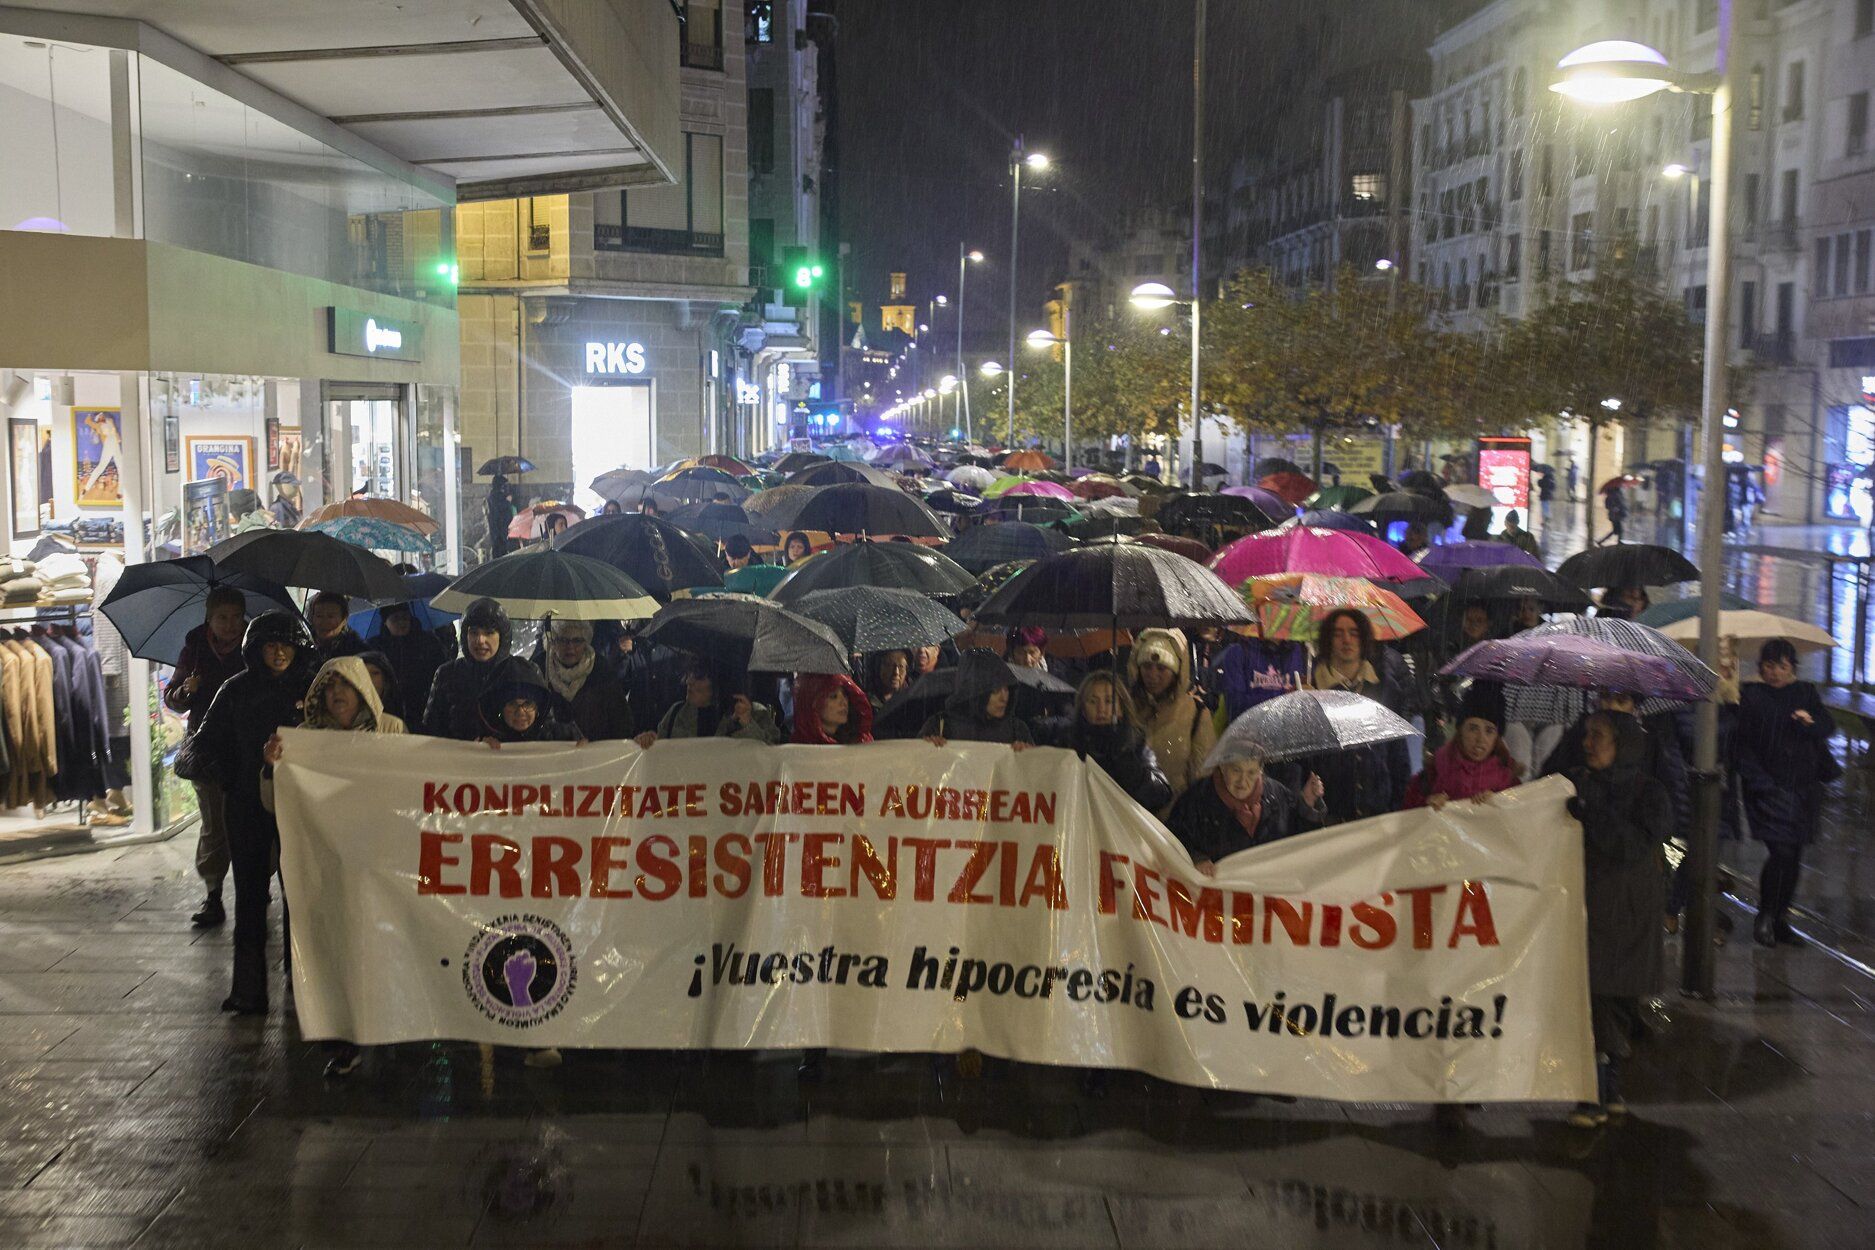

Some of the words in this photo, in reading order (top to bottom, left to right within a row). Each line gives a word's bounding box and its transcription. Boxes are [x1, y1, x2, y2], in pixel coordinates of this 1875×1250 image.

[586, 342, 645, 373] RKS
[423, 782, 707, 818] KONPLIZITATE
[719, 781, 865, 817] SAREEN
[879, 783, 1056, 824] AURREAN
[418, 831, 1069, 910] ERRESISTENTZIA
[1097, 850, 1500, 950] FEMINISTA
[687, 943, 889, 997] ¡Vuestra
[906, 946, 1155, 1011] hipocresía
[1174, 986, 1227, 1024] es
[1243, 991, 1507, 1040] violencia!
